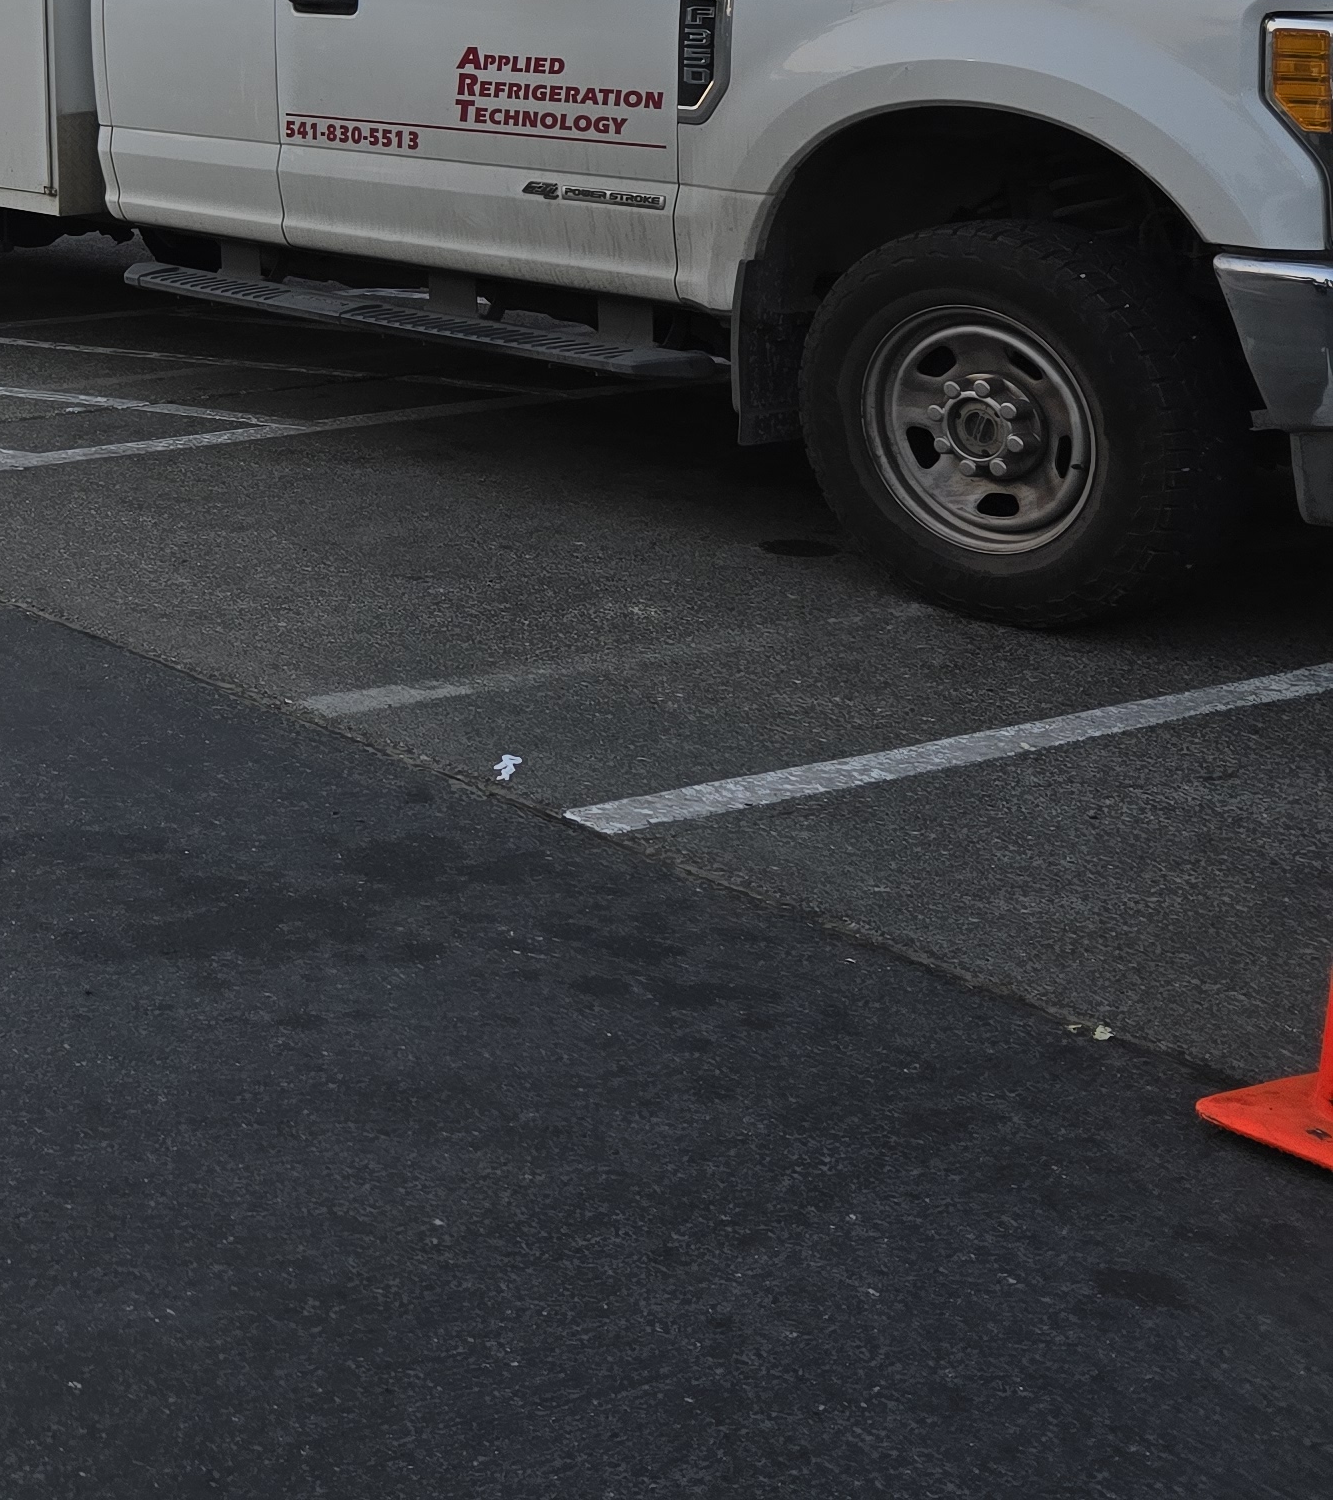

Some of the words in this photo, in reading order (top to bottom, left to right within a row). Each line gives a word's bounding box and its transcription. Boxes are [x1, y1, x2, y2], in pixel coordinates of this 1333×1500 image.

[456, 47, 565, 75] APPLIED
[683, 6, 715, 85] F350
[456, 73, 664, 110] REFRIGERATION
[455, 99, 629, 135] TECHNOLOGY
[285, 120, 419, 150] 541-830-5513
[564, 187, 607, 200] POWER
[608, 192, 661, 205] STROKE
